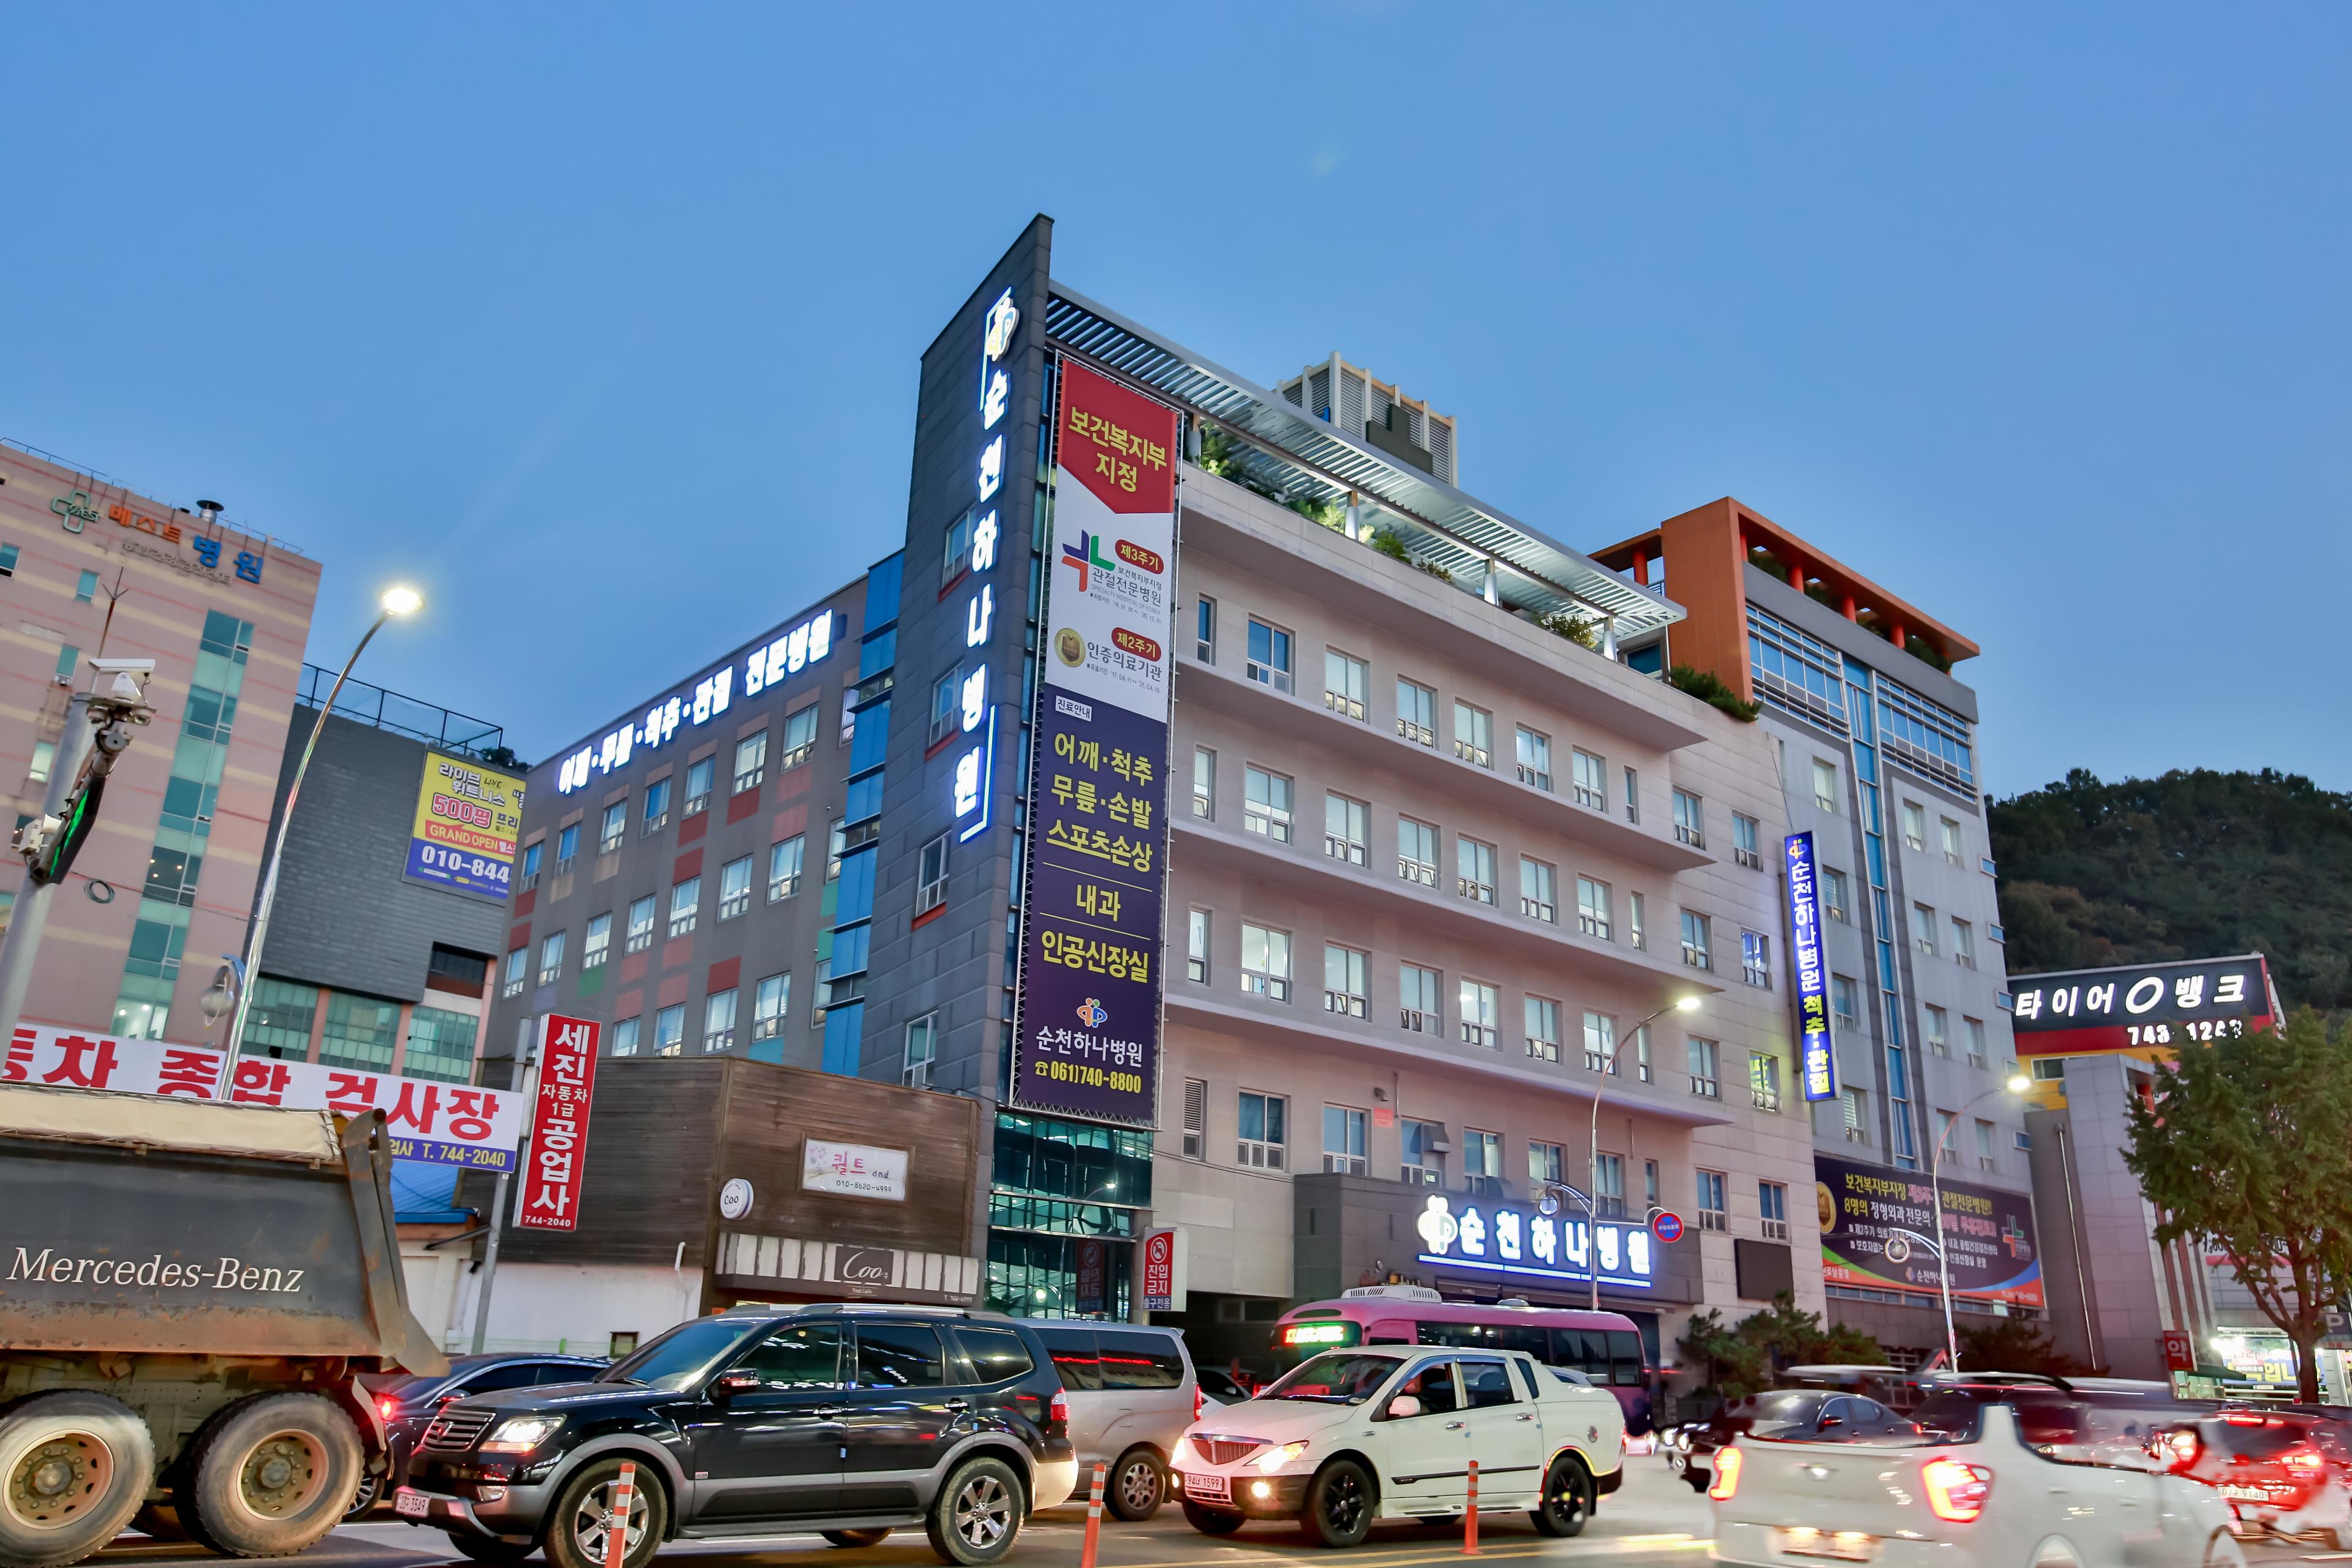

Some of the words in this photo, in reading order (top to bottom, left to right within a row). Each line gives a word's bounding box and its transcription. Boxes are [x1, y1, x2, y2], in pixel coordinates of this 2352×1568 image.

[1068, 406, 1167, 471] 보건복지부
[1095, 452, 1137, 492] 지정
[108, 504, 181, 544] 베스트
[193, 535, 264, 584] 병원
[1121, 544, 1159, 571] 제3주기
[1093, 567, 1161, 607] 관절전문병원
[1118, 567, 1161, 591] 보건복지부지정
[1117, 632, 1156, 658] 제2주기
[1088, 642, 1162, 682] 인증의료기관
[1057, 697, 1091, 720] 진료안내
[439, 763, 481, 785] 라이브
[433, 793, 491, 827] 500평
[430, 825, 470, 843] GRAND
[472, 835, 497, 850] OPEN
[1046, 819, 1153, 873] 스포츠손상
[422, 845, 511, 883] 010-844
[1076, 884, 1121, 922] 내과
[1792, 861, 1821, 993] 순천하나병원
[1041, 930, 1150, 984] 인공신장실
[1036, 1025, 1142, 1068] 순천하나병원
[157, 1049, 292, 1105] 종합
[1050, 1060, 1142, 1093] 061)740-8800
[541, 1084, 587, 1102] 자동차
[552, 1102, 575, 1117] 1급
[423, 1144, 434, 1159] T.
[440, 1145, 506, 1167] 744-2040
[532, 1118, 578, 1216] 공업사
[832, 1151, 866, 1175] 퀼트
[836, 1180, 892, 1193] 010-8620-4999
[1845, 1173, 1906, 1201] 보건복지부지정
[525, 1215, 571, 1227] 744-2040
[1844, 1197, 1868, 1216] 8명의
[1871, 1201, 1905, 1223] 정형외과
[1905, 1207, 1931, 1227] 전문의
[1459, 1207, 1651, 1275] 순천하나병원
[6, 1247, 304, 1294] Mercedes-Benz
[843, 1251, 884, 1279] Coo
[1148, 1264, 1167, 1279] 진입
[1147, 1280, 1167, 1295] 금지
[1144, 1297, 1170, 1309] 출구전용
[1204, 1478, 1219, 1488] 1599
[2242, 1490, 2264, 1499] 9140
